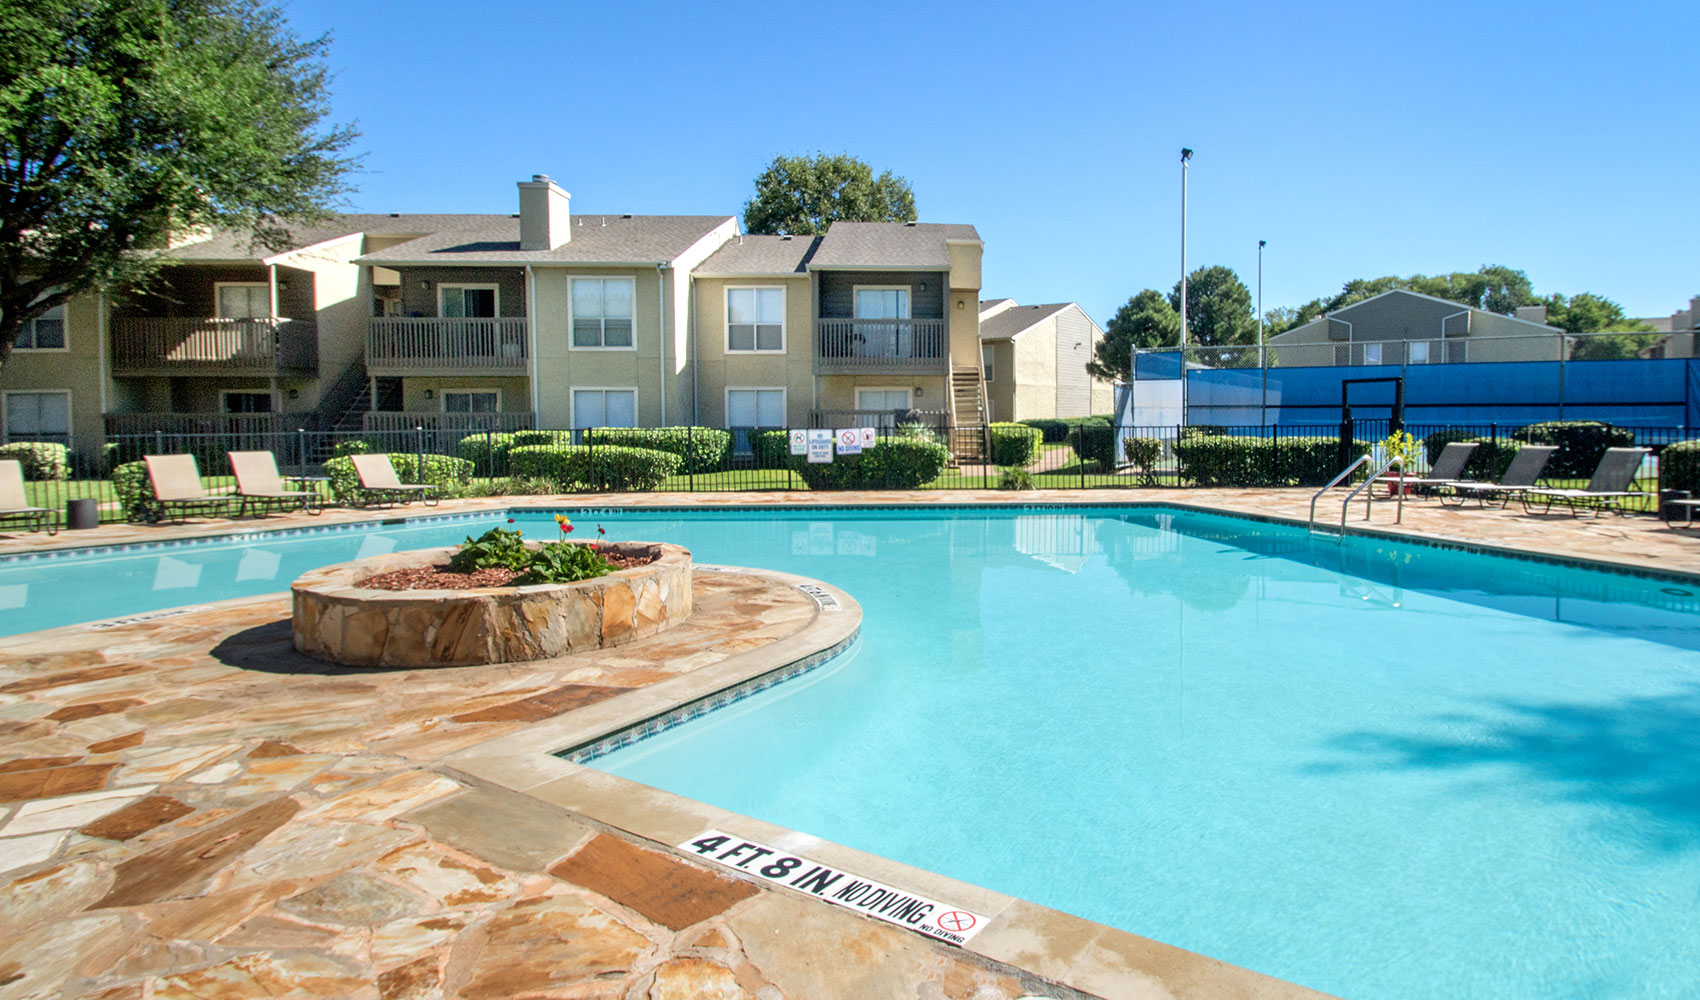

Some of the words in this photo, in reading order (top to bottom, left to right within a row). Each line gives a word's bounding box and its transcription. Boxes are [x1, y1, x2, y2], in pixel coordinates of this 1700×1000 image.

[691, 836, 731, 854] 4
[716, 843, 774, 869] FT.
[760, 857, 802, 878] 8
[789, 866, 845, 896] IN.
[832, 880, 872, 902] NO
[856, 888, 934, 924] DIVING
[920, 923, 933, 932] NO
[933, 929, 965, 943] DIVING
